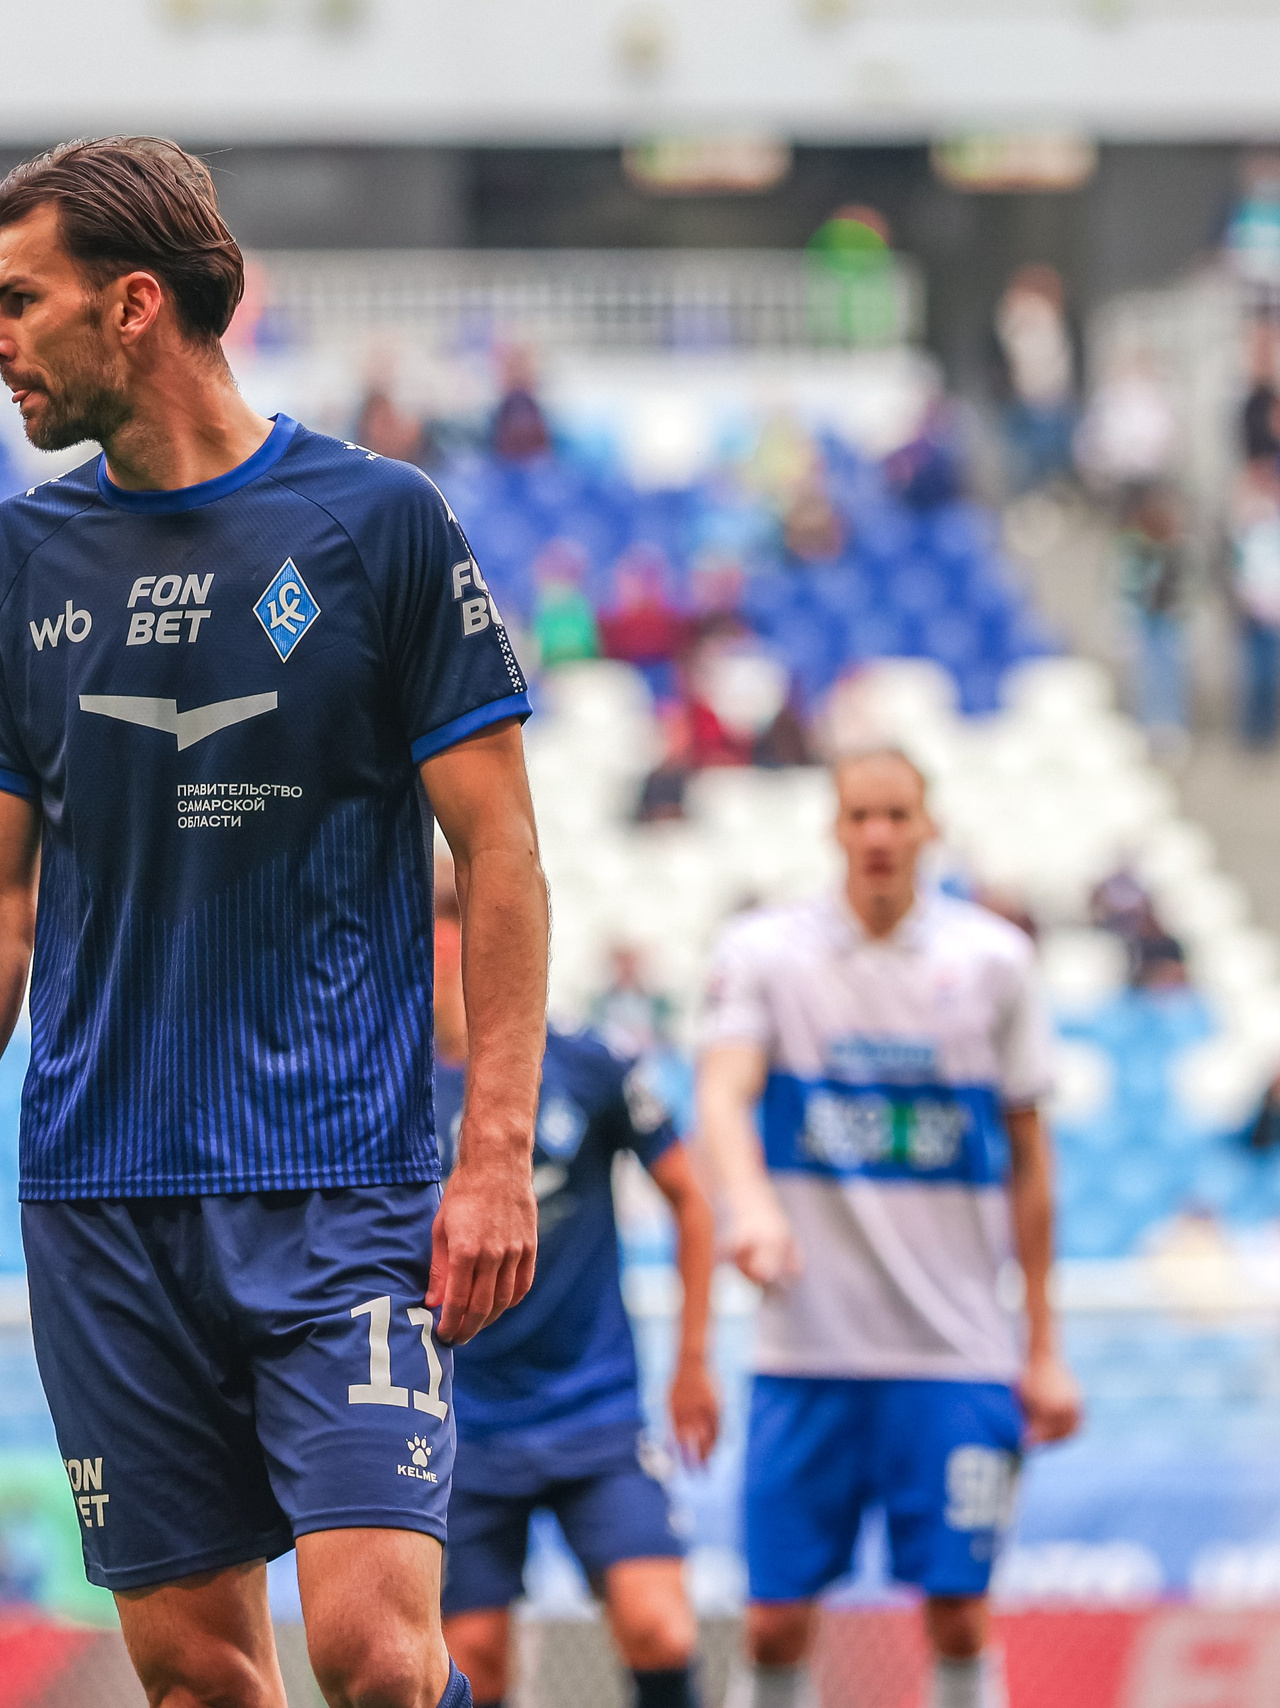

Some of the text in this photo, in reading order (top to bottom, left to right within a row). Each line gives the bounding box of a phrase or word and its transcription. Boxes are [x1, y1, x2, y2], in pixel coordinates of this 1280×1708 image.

[126, 573, 215, 608] FON
[29, 599, 93, 651] wb
[126, 610, 212, 646] BET
[177, 783, 303, 798] ПРАВИТЕЛЬСТВО
[177, 797, 265, 813] САМАРСКОЙ
[177, 815, 242, 829] ОБЛАСТИ
[348, 1295, 448, 1424] 11
[63, 1457, 103, 1492] ON
[397, 1464, 438, 1483] KELME
[75, 1493, 110, 1528] ET
